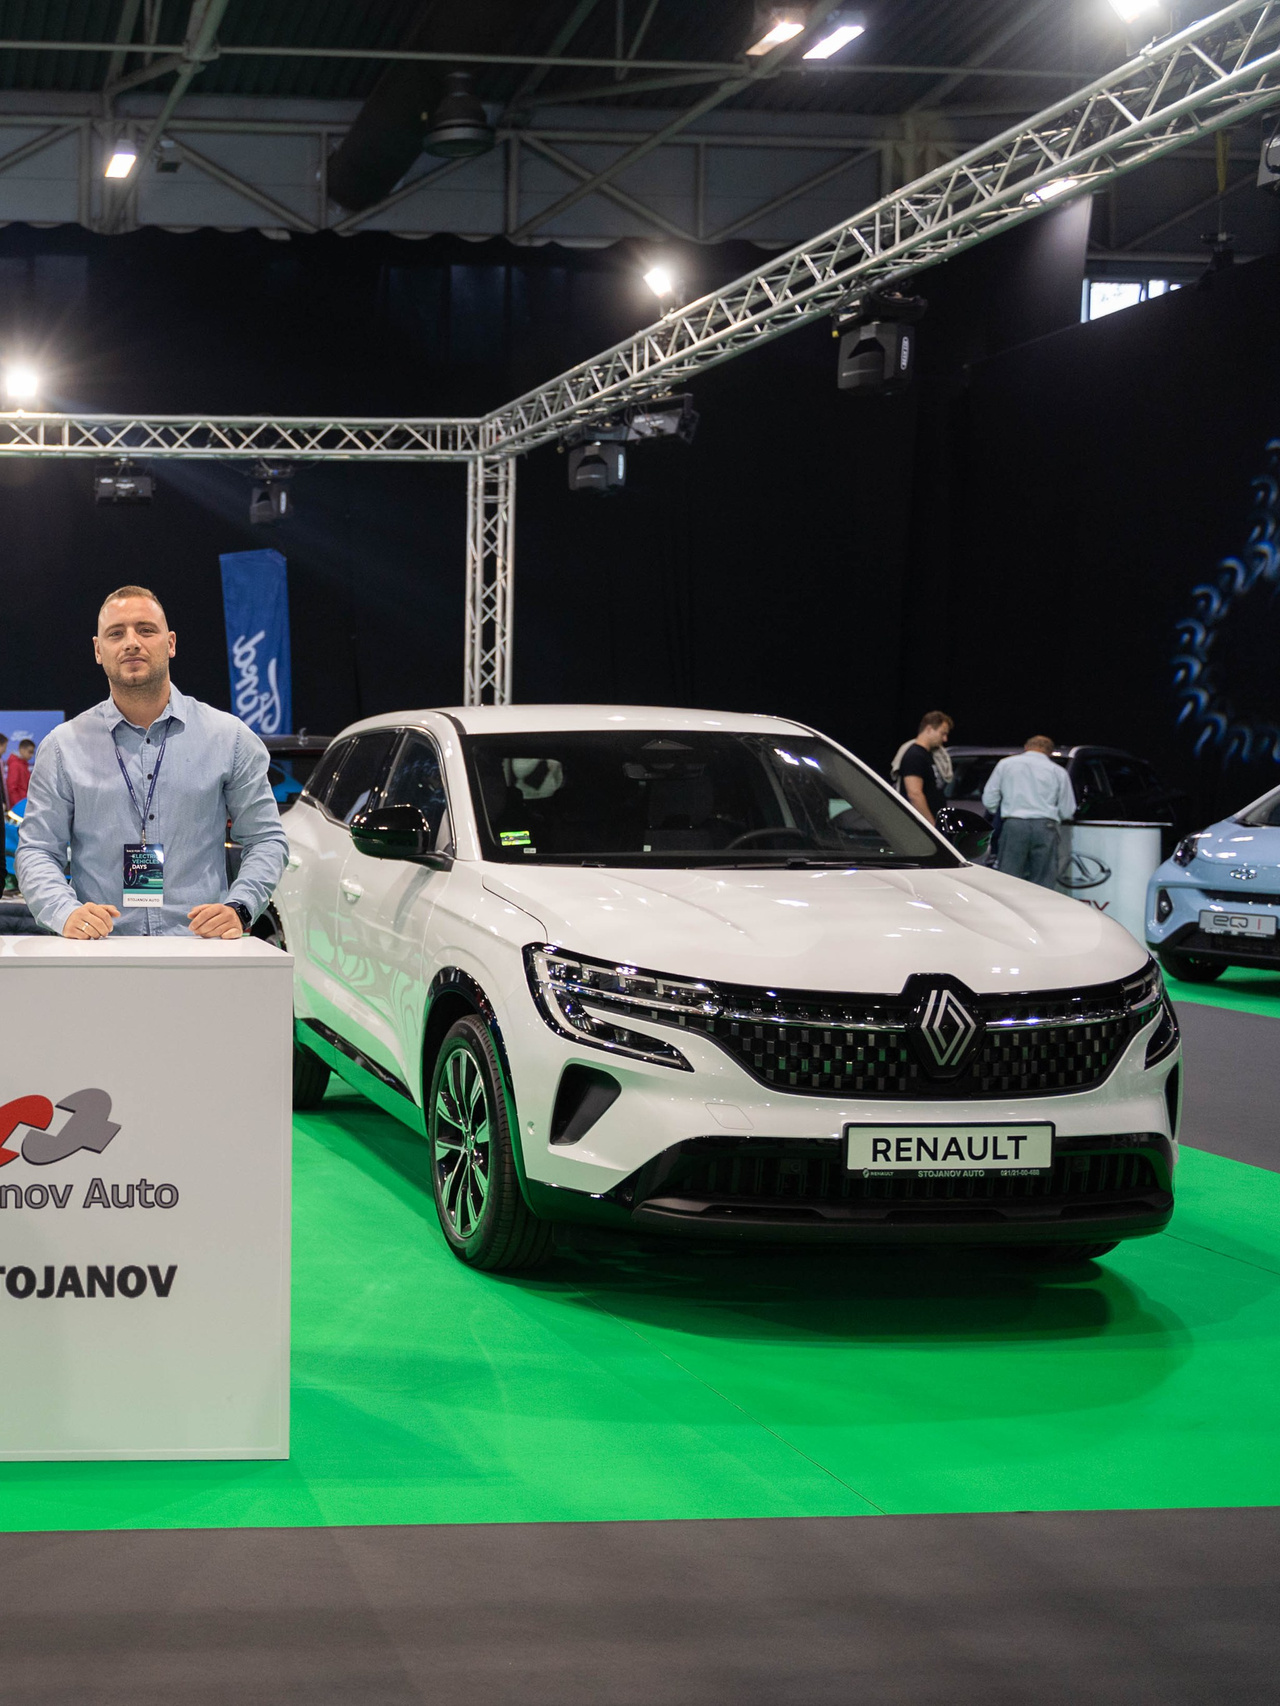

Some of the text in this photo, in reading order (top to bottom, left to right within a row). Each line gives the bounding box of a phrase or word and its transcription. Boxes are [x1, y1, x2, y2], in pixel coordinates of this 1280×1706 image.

[872, 1135, 1027, 1163] RENAULT
[917, 1169, 985, 1178] STOJANOV AUTO
[83, 1177, 180, 1209] Auto
